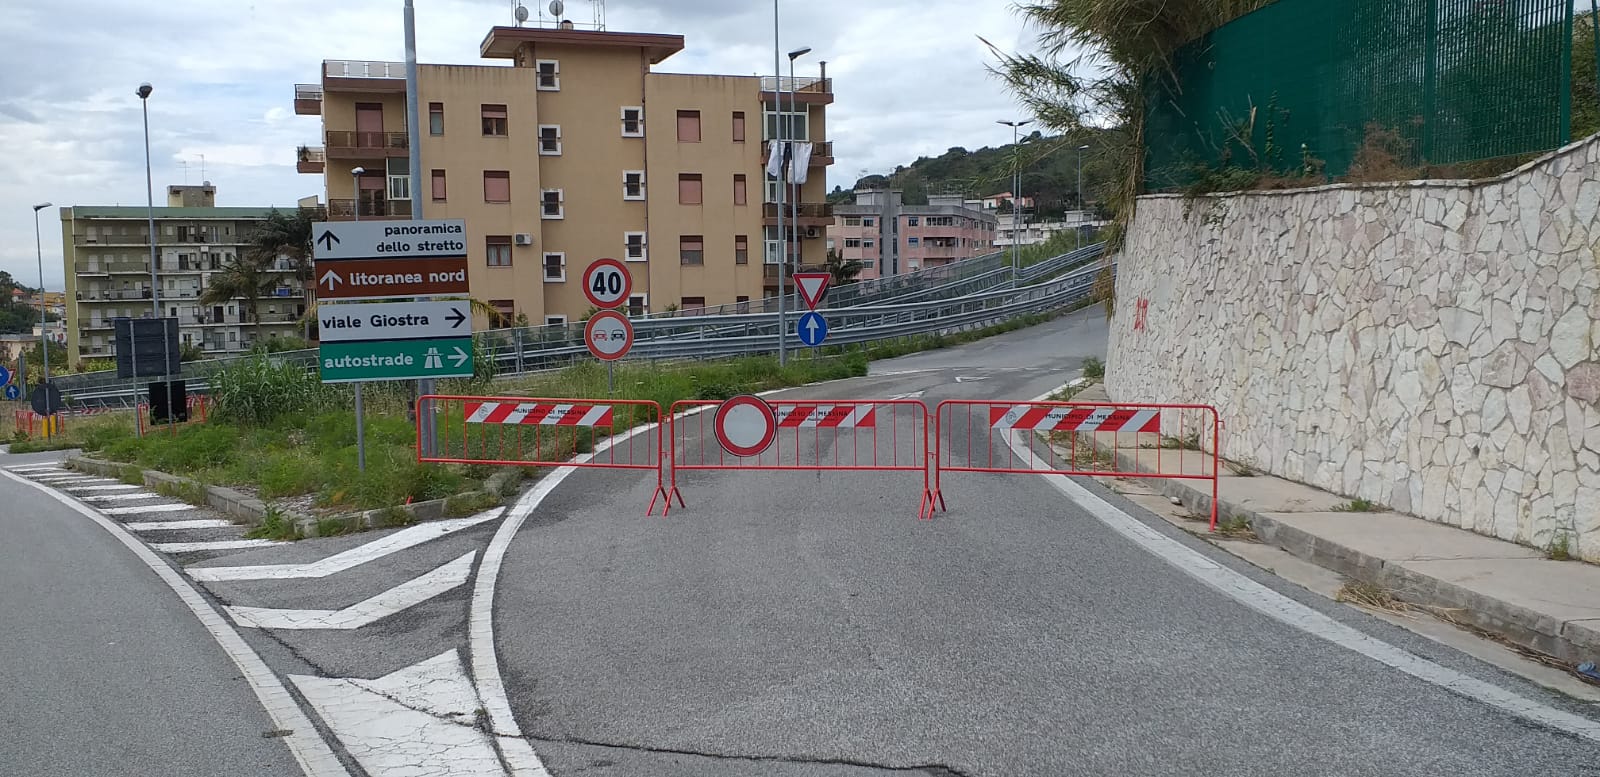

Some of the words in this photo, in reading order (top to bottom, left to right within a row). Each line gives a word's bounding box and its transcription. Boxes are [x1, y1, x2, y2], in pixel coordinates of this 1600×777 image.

[384, 223, 462, 237] panoramica
[376, 242, 410, 253] dello
[418, 240, 464, 251] stretto
[349, 271, 423, 286] litoranea
[429, 269, 465, 283] nord
[592, 271, 622, 295] 40
[322, 315, 362, 329] viale
[370, 313, 429, 327] Giostra
[324, 353, 414, 369] autostrade
